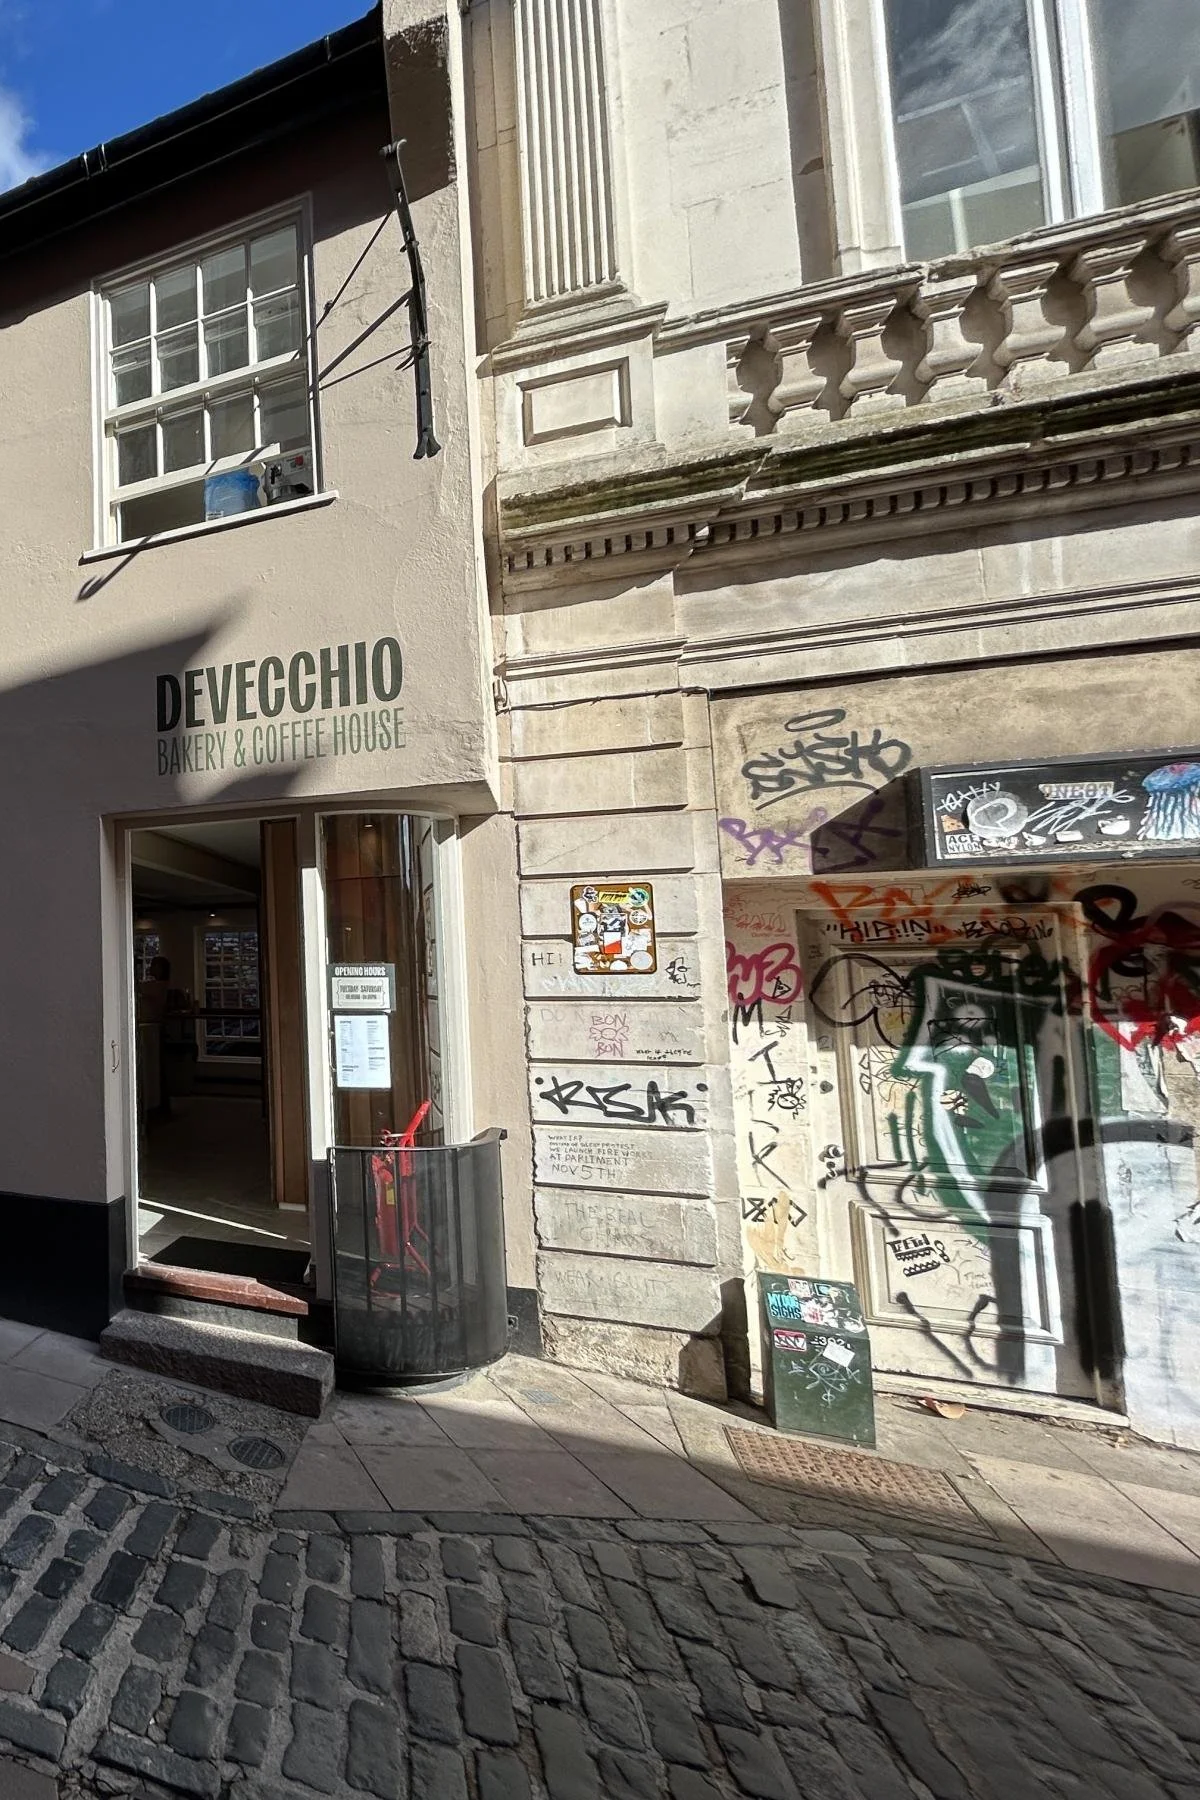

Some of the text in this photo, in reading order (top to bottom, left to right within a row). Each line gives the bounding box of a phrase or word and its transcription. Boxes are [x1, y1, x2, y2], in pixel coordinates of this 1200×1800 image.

[156, 636, 404, 732] DEVECCHIO
[158, 707, 406, 776] BAKERY & COFFEE HOUSE
[335, 966, 386, 976] OPENING HOURS
[591, 1013, 628, 1027] BON
[771, 1304, 802, 1319] SIGHS
